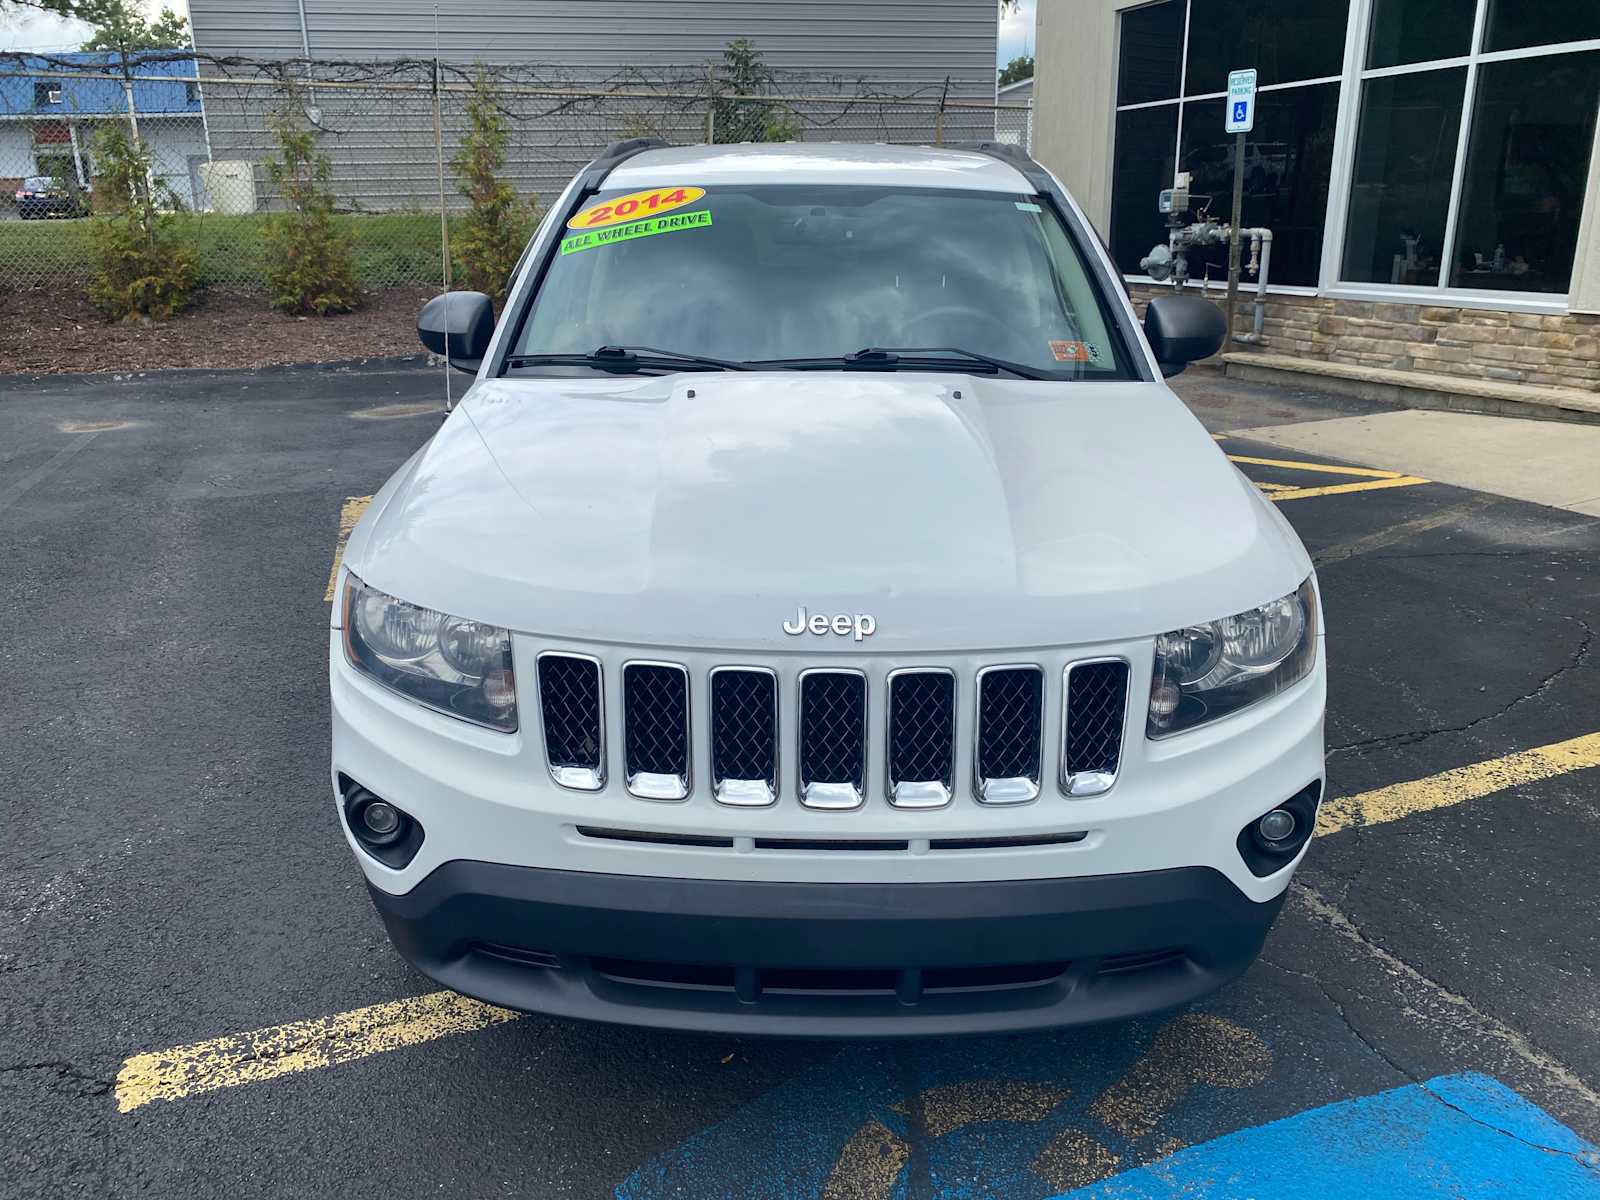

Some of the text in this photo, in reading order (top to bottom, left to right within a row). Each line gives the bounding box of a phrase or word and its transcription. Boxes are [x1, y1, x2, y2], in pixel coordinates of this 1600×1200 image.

[1231, 87, 1252, 96] PARKING
[587, 189, 688, 225] 2014
[564, 213, 709, 252] ALL WHEEL DRIVE
[783, 606, 876, 642] Jeep
